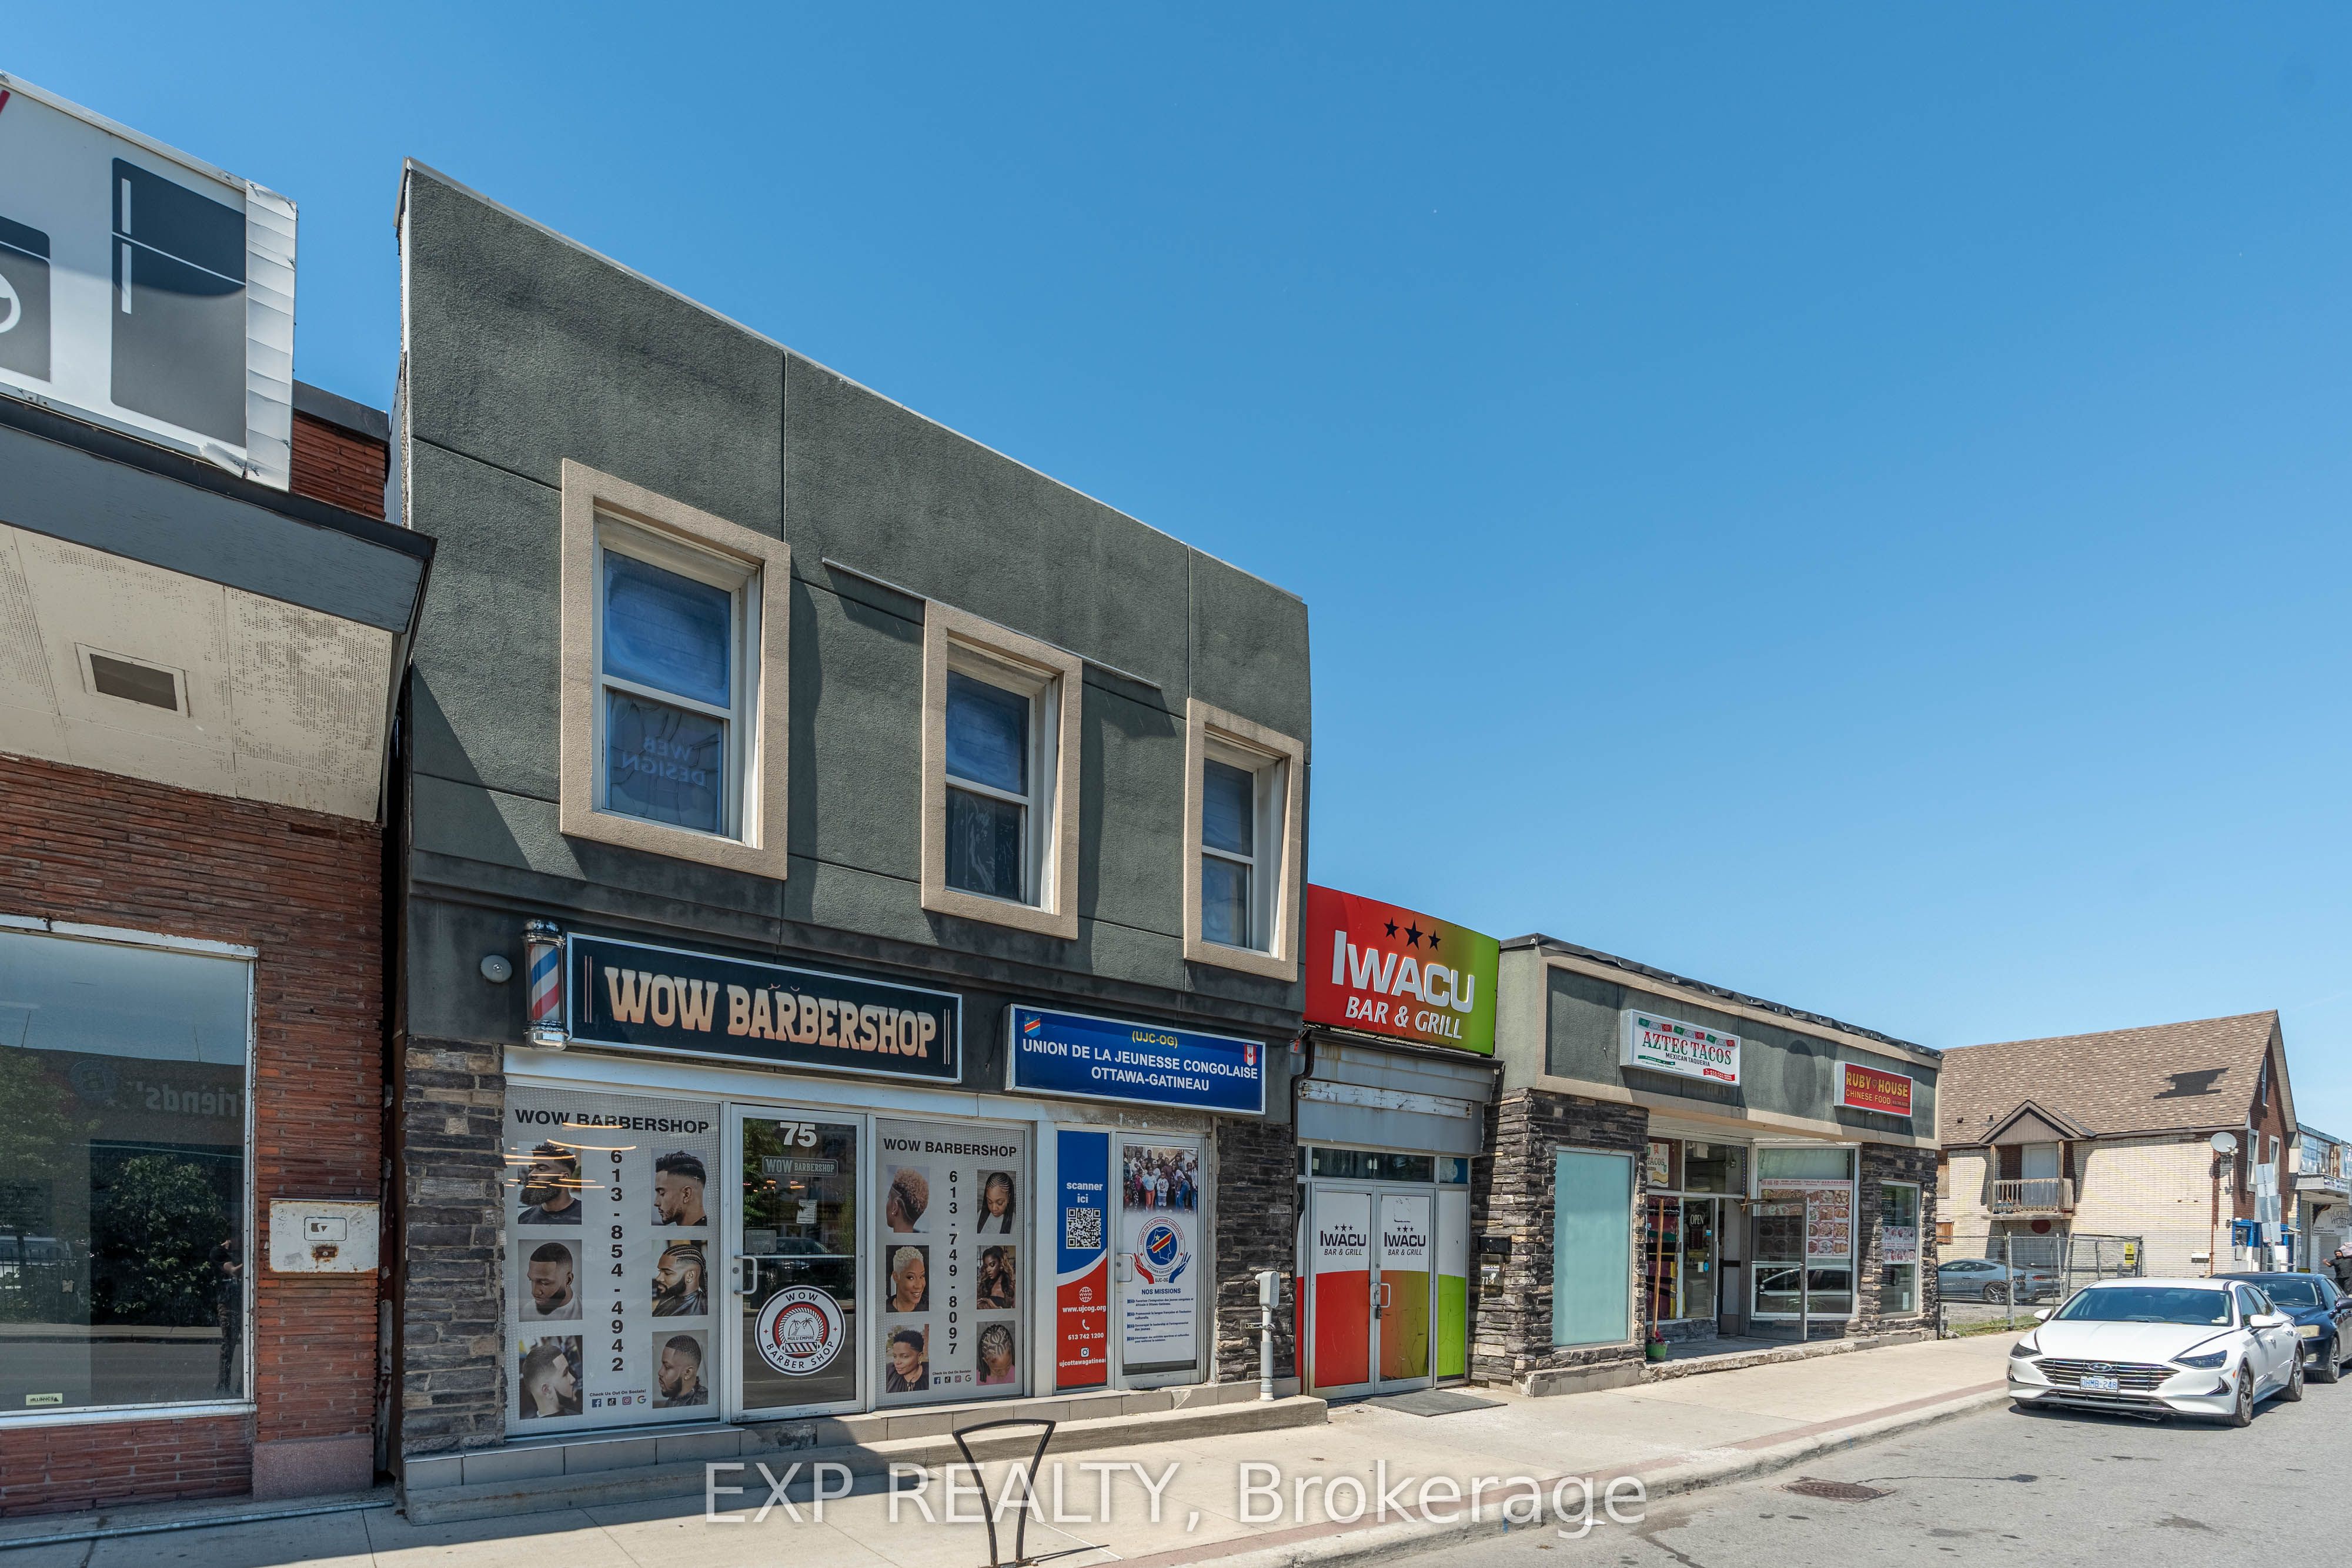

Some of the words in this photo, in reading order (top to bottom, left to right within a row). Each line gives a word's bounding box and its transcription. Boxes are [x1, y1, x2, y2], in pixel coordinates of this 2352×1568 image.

[1331, 930, 1475, 1014] IWACU
[604, 966, 719, 1032] WOW
[727, 984, 936, 1058] BARBERSHOP
[1345, 996, 1389, 1025] BAR
[1394, 1005, 1409, 1028] &
[1415, 1010, 1462, 1039] GRILL
[1132, 1031, 1178, 1049] (UJC-OG)
[1642, 1031, 1688, 1055] AZTEC
[1690, 1041, 1732, 1065] TACOS
[1023, 1038, 1067, 1057] UNION
[1072, 1044, 1090, 1059] DE
[1094, 1047, 1112, 1062] LA
[1114, 1051, 1180, 1070] JEUNESSE
[1183, 1059, 1258, 1079] CONGOLAISE
[1665, 1052, 1688, 1062] MEXICAN
[1688, 1057, 1710, 1067] TAQUERIA
[1091, 1066, 1210, 1091] OTTAWA-GATINEAU
[1846, 1072, 1872, 1089] RUBY
[1878, 1079, 1909, 1098] HOUSE
[1846, 1089, 1873, 1101] CHINESE
[1875, 1096, 1891, 1105] FOOD
[514, 1109, 570, 1125] WOW
[576, 1112, 710, 1134] BARBERSHOP
[780, 1122, 817, 1147] 75
[883, 1138, 921, 1152] WOW
[925, 1141, 1017, 1158] BARBERSHOP
[766, 1159, 793, 1173] WOW
[794, 1162, 834, 1173] BARBERSHOP
[1066, 1182, 1103, 1191] scanner
[1077, 1193, 1088, 1203] ici
[1690, 1213, 1704, 1225] OPEN
[1320, 1231, 1367, 1247] IWACU
[1384, 1232, 1426, 1247] IWACU
[1482, 1276, 1489, 1285] 77
[786, 1292, 818, 1302] WOW
[1063, 1305, 1107, 1313] www.ujcog.org
[766, 1343, 805, 1369] BARBER
[811, 1340, 834, 1366] SHOP
[2103, 1380, 2117, 1389] 248
